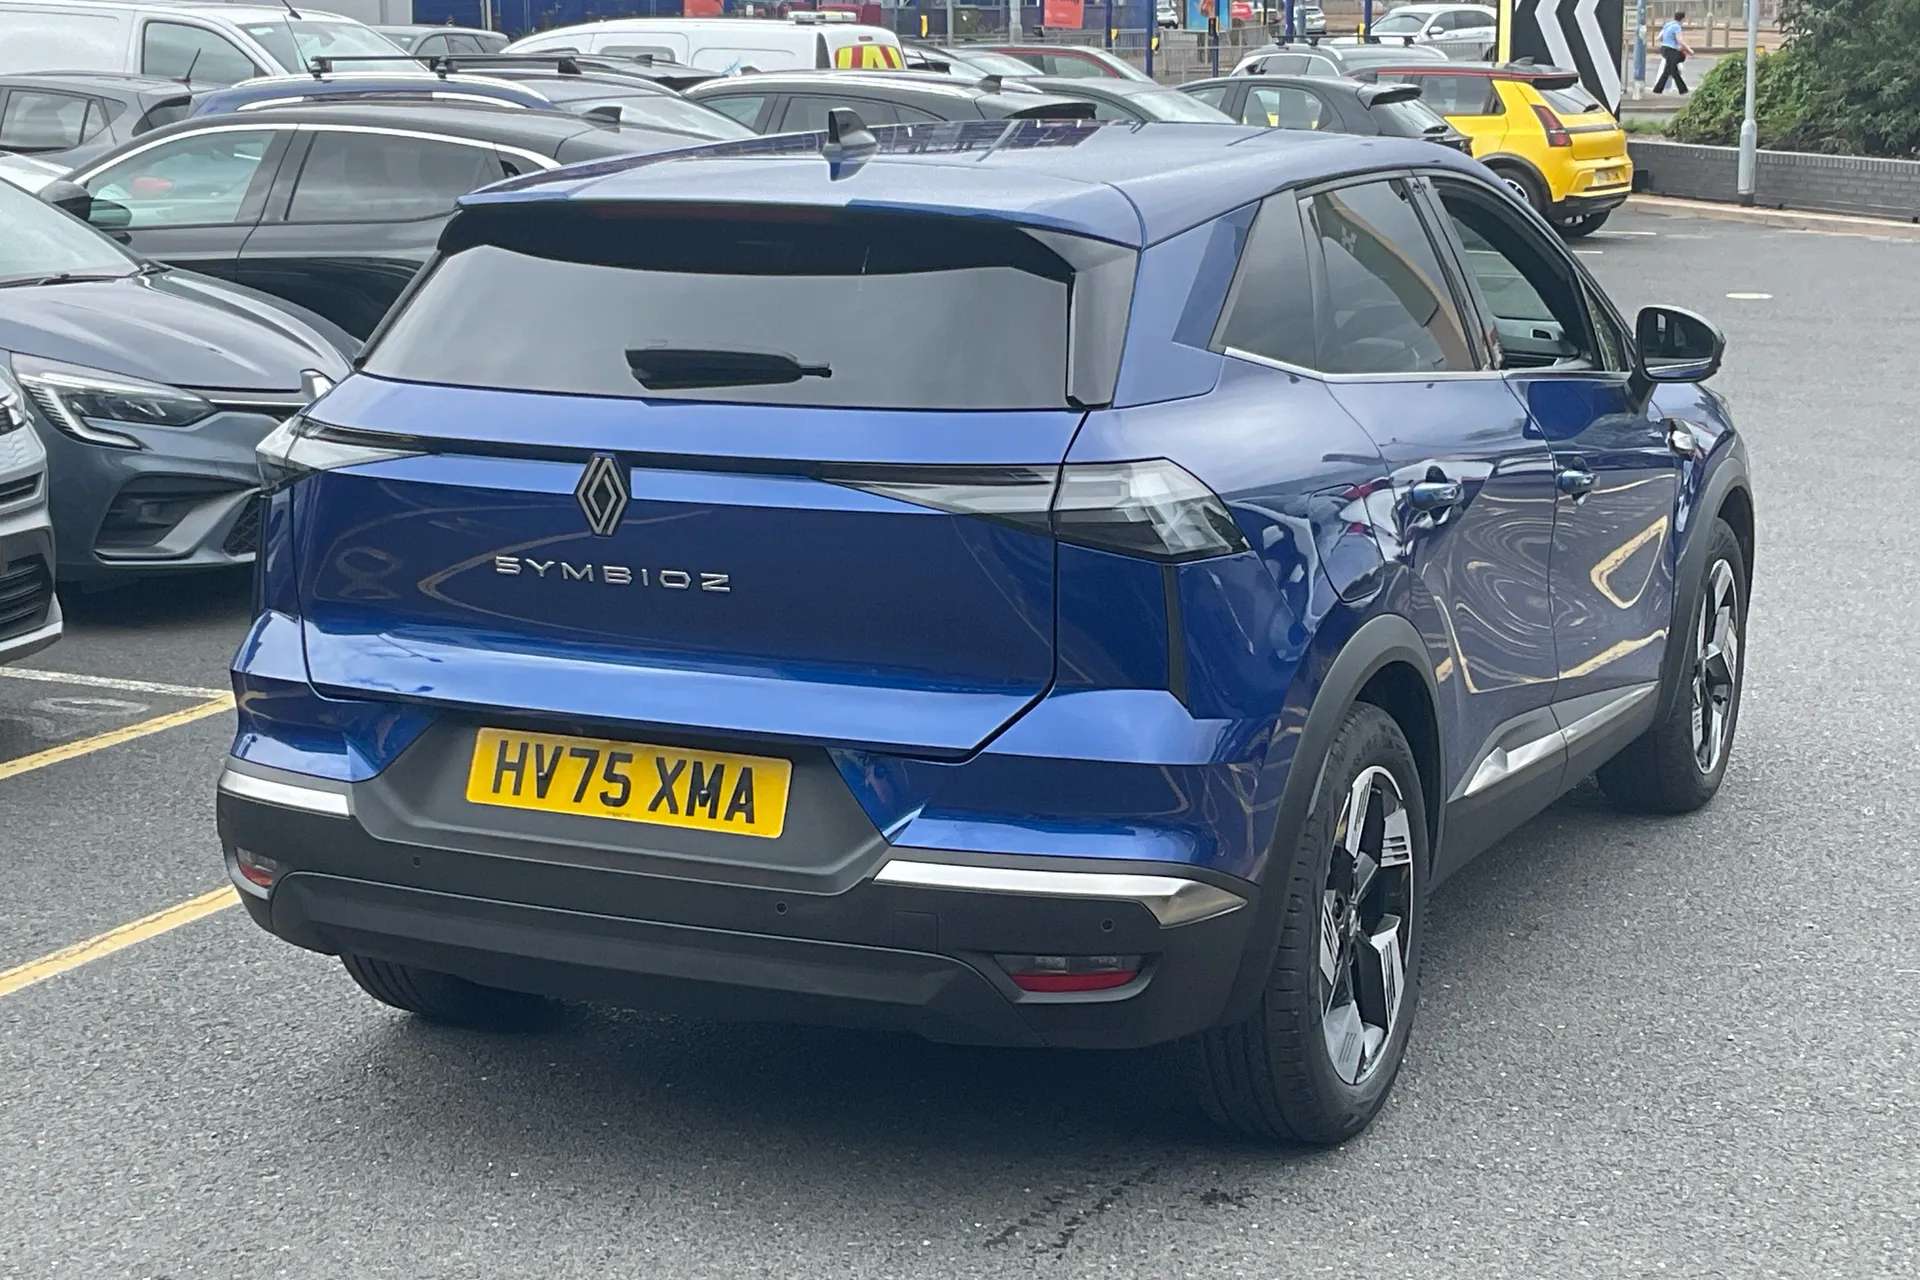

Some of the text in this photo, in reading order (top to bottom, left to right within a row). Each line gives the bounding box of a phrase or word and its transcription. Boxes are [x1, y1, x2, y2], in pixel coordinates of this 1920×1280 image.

[495, 555, 732, 593] SYMBIOZ
[492, 739, 756, 825] HV75 XMA
